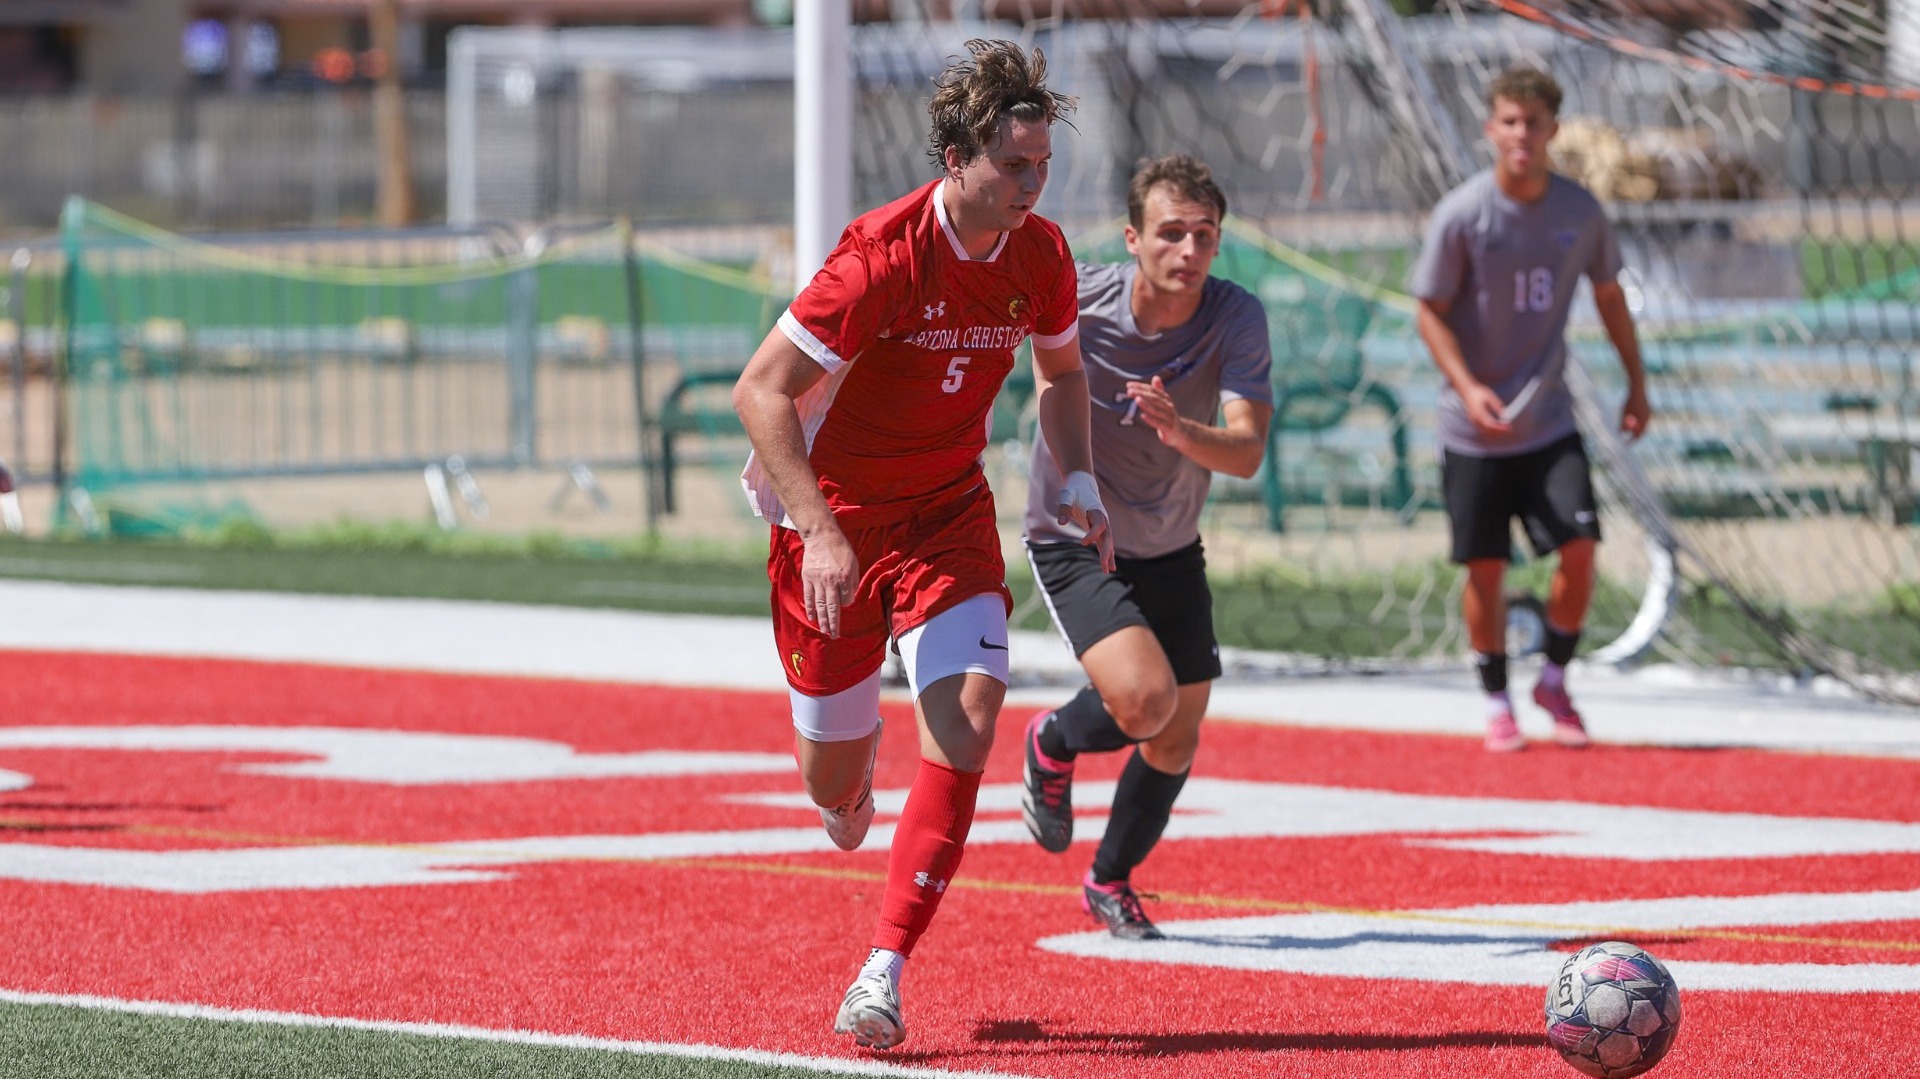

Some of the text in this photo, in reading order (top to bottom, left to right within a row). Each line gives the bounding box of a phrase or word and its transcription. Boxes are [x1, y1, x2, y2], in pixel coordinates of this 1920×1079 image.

[1514, 267, 1553, 312] 18
[941, 356, 972, 393] 5
[1115, 392, 1138, 425] 7
[1558, 950, 1583, 1008] ELECT
